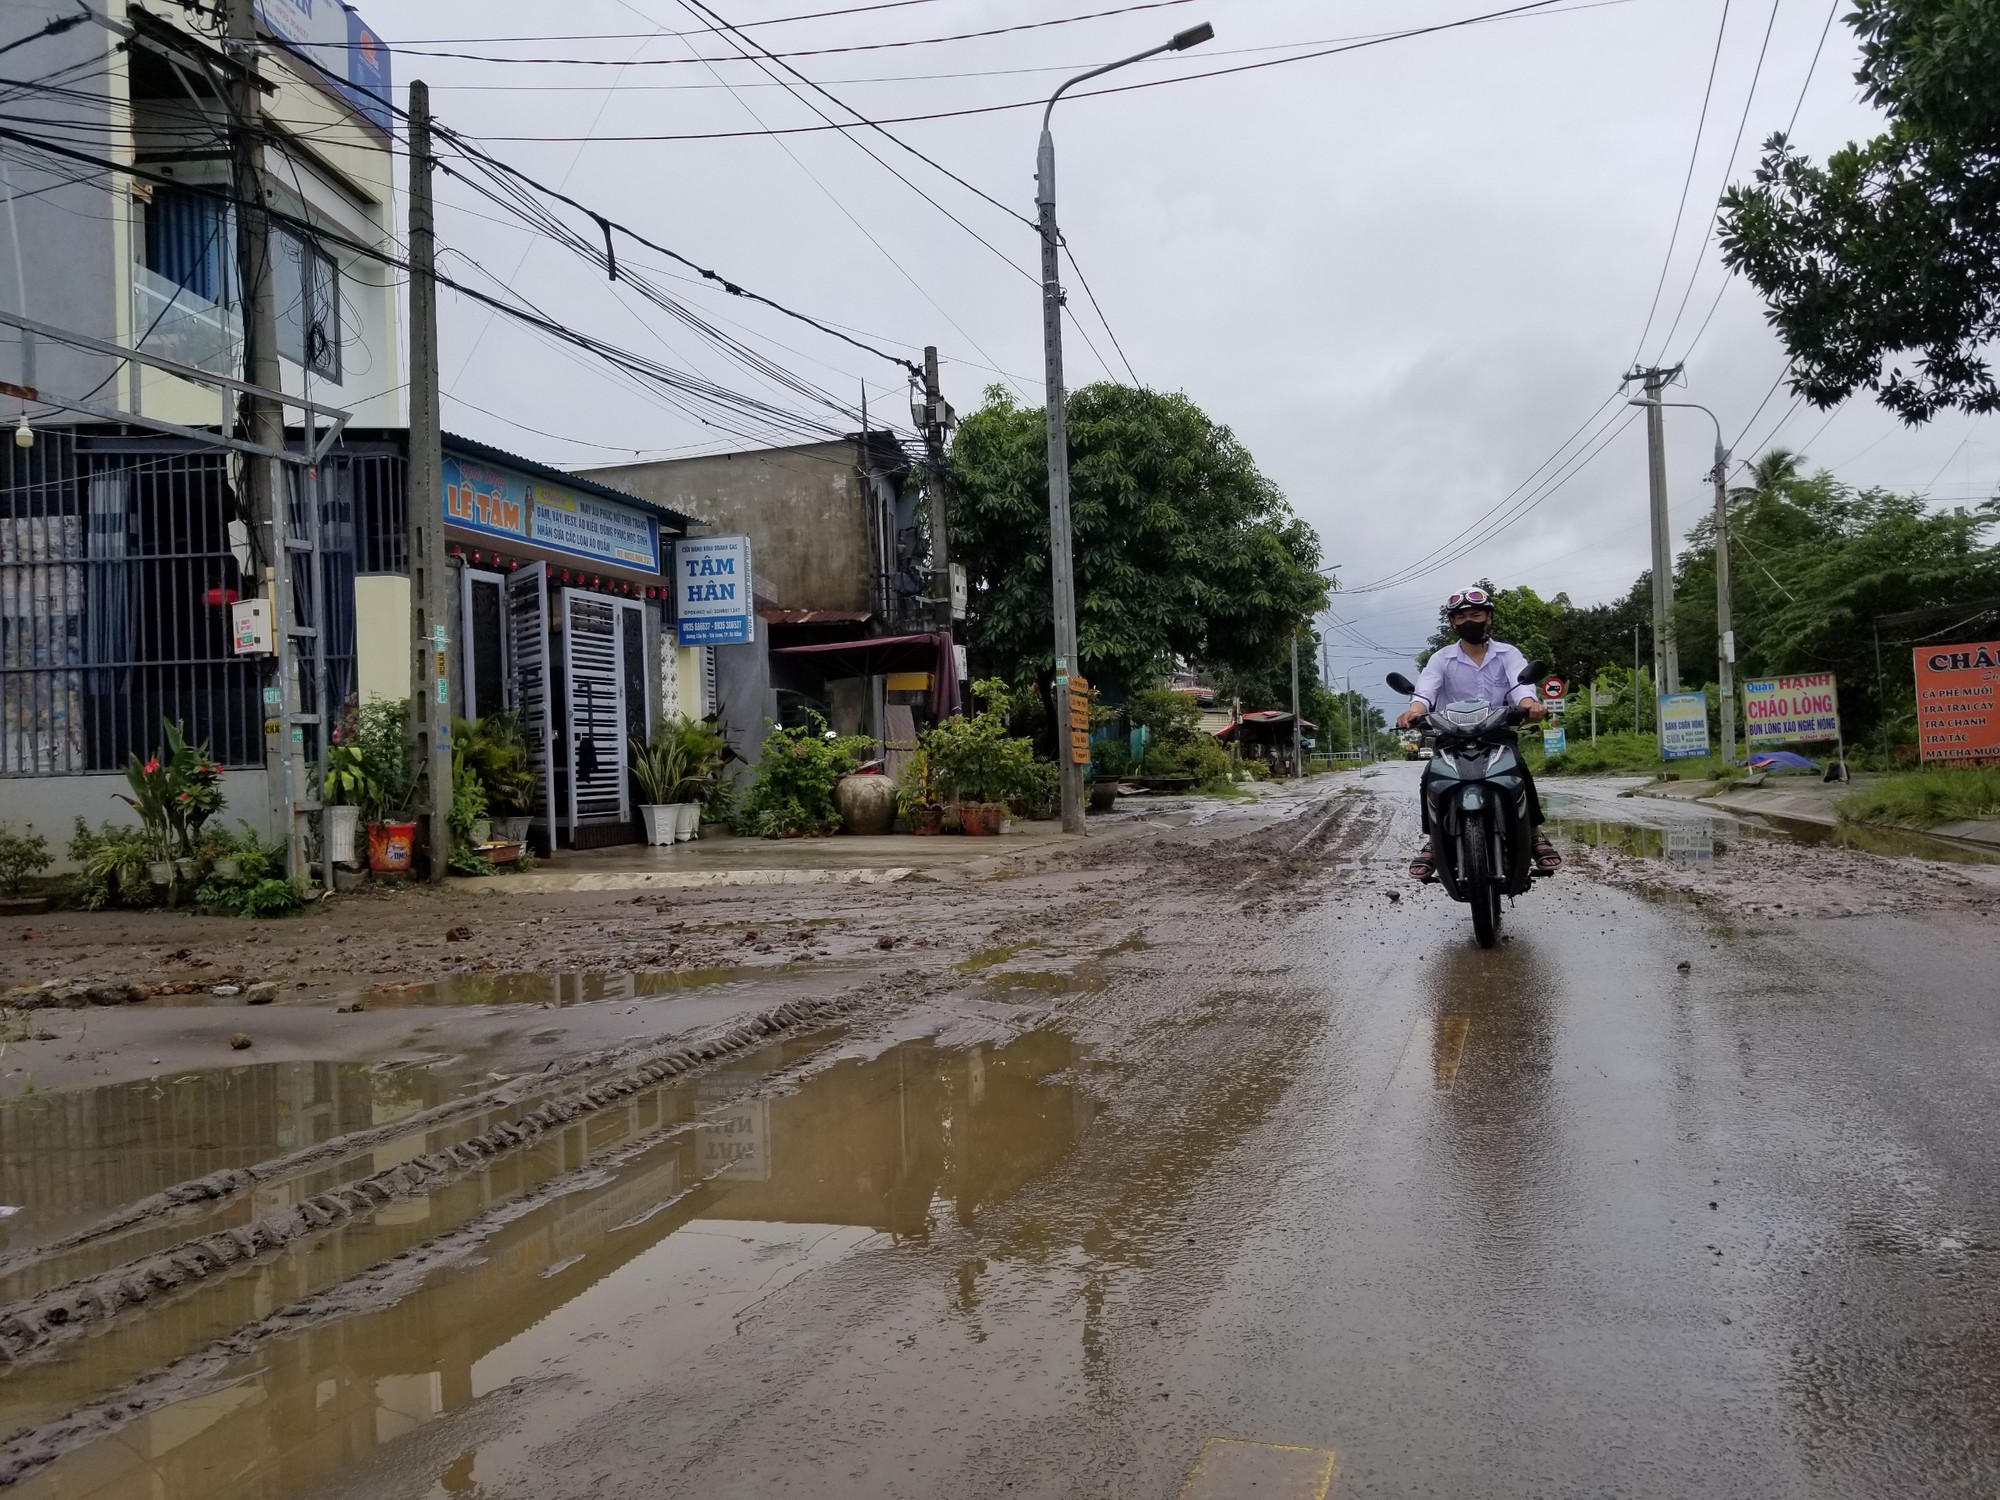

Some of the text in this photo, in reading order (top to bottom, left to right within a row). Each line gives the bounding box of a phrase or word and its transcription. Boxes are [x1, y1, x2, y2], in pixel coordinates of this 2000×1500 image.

[448, 481, 520, 532] LÊ TÂM
[686, 555, 735, 577] TÂM
[687, 580, 735, 602] HÂN
[1747, 675, 1831, 693] Quán HẠNH
[1922, 684, 1993, 699] CÀ PHÊ MUỐI
[1748, 691, 1833, 719] CHÁO LÒNG
[1924, 704, 1944, 714] TRÀ
[1946, 702, 1971, 713] TRÁI
[1749, 715, 1836, 736] BÚN LÒNG XÀO NGHỆ NÓNG
[1925, 717, 1986, 729] TRÀ CHANH
[1926, 731, 1969, 744] TRÀ TẮC
[1926, 749, 1972, 758] MATCHA
